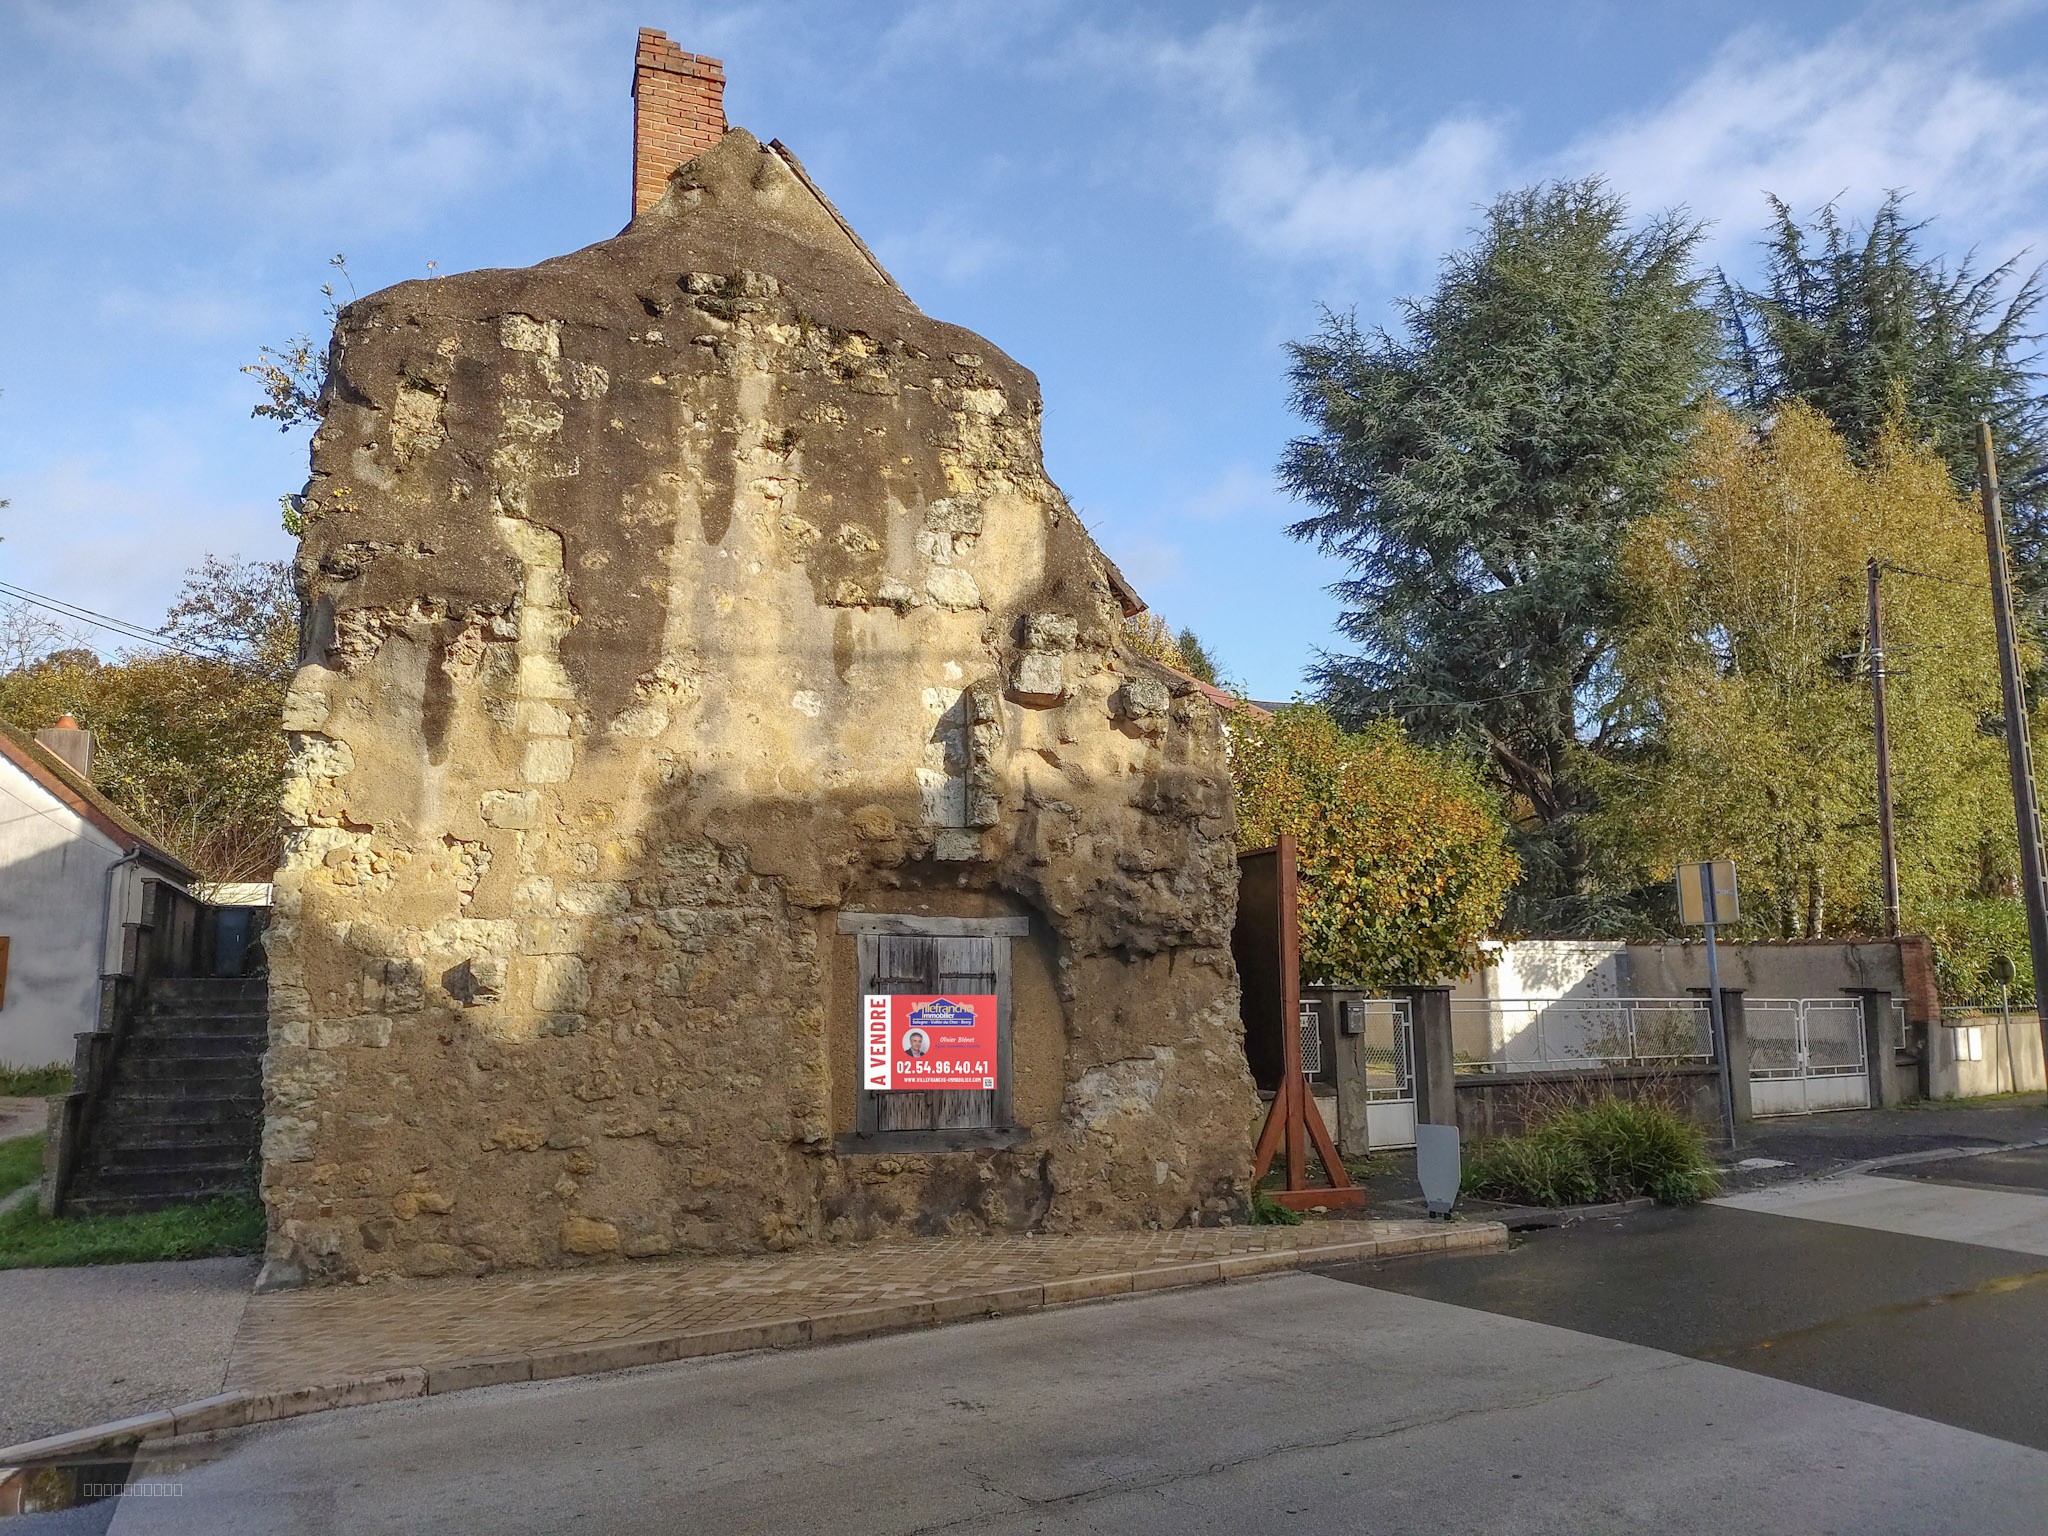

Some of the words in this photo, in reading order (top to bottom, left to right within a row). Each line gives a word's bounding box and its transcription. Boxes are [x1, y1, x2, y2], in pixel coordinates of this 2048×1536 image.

[911, 1002, 974, 1013] Villefranche
[870, 998, 886, 1068] VENDRE
[896, 1060, 988, 1074] 02.54.96.40.41
[870, 1075, 886, 1086] A
